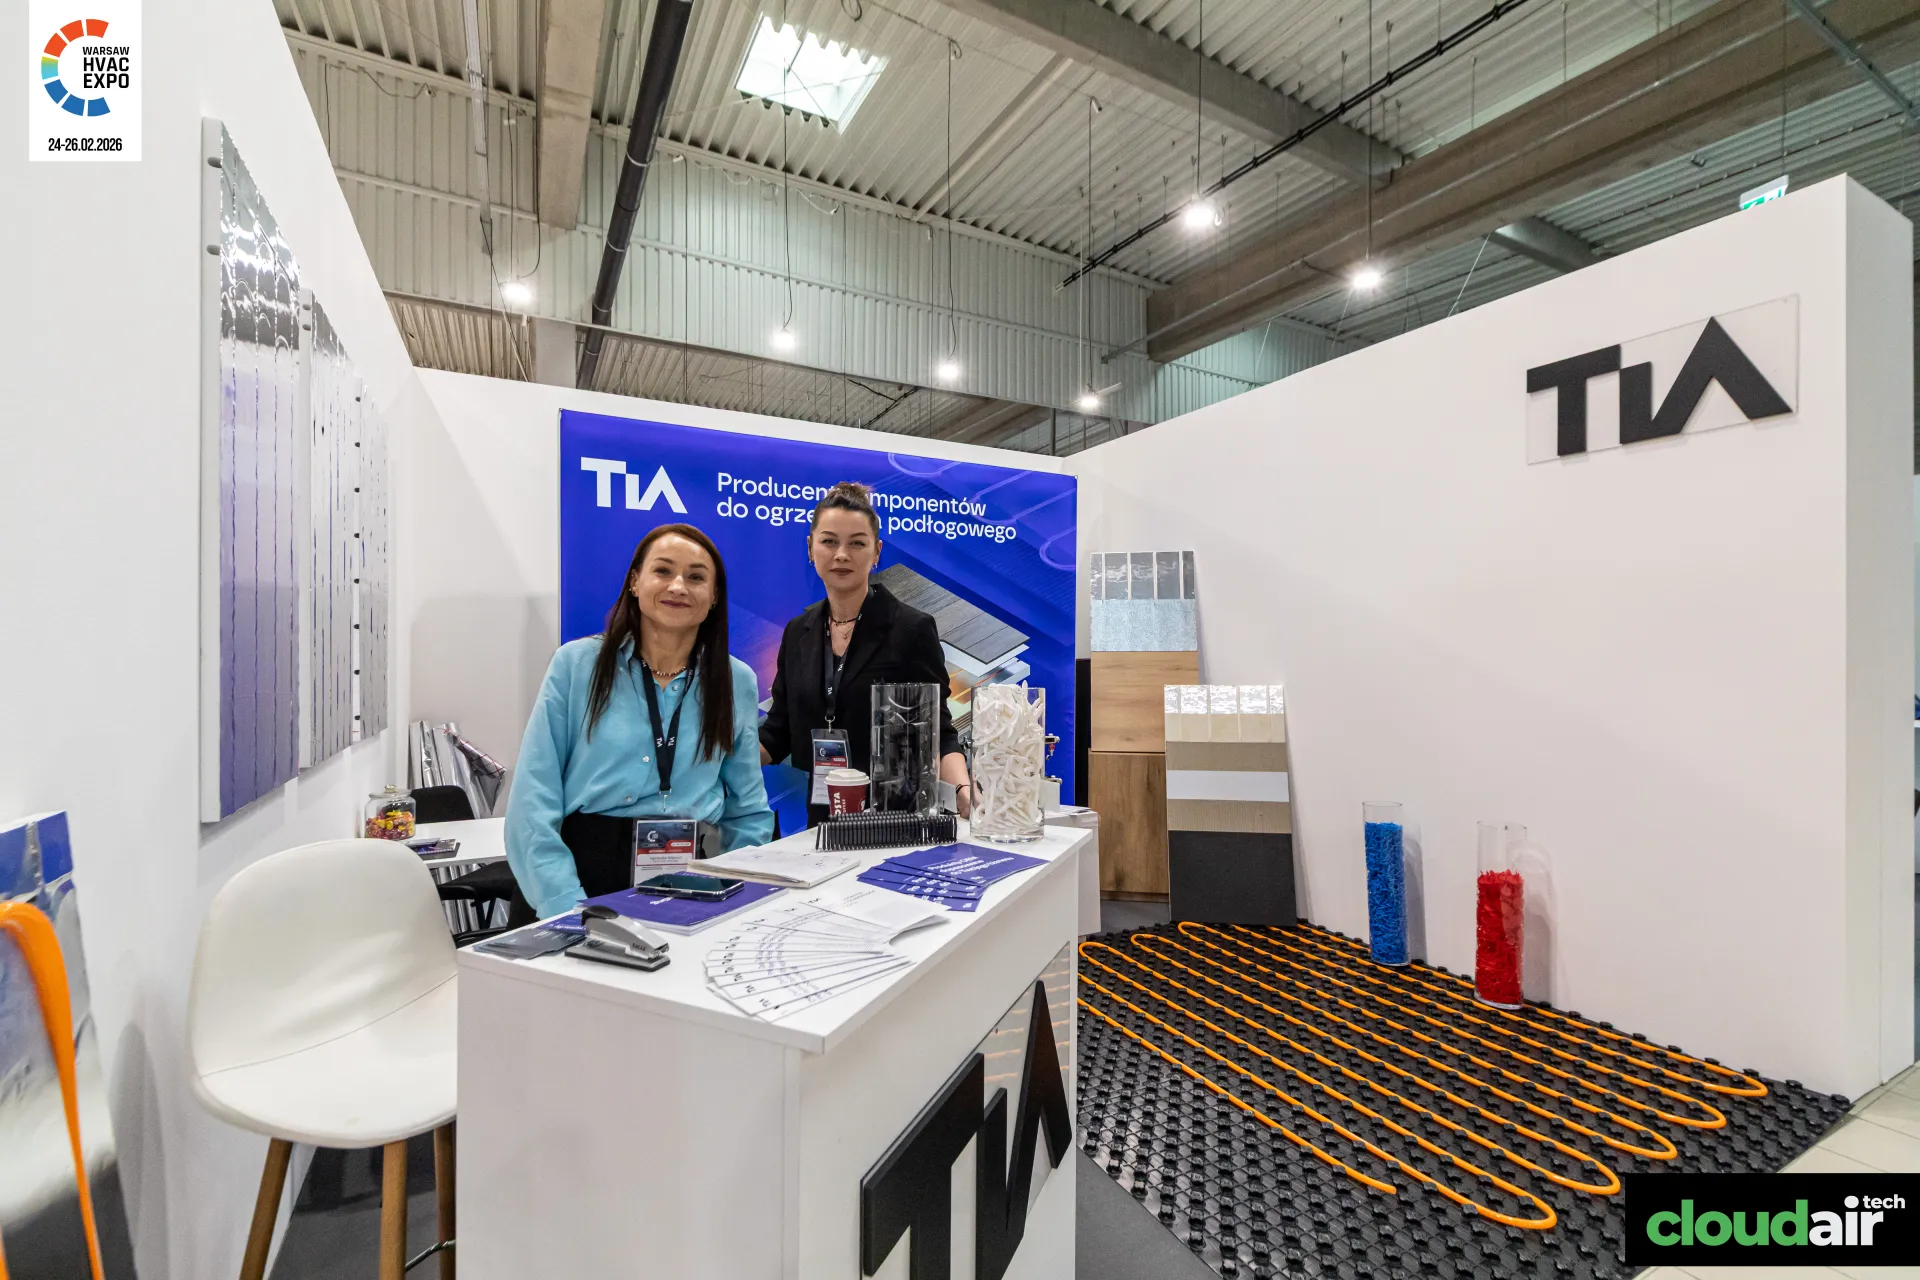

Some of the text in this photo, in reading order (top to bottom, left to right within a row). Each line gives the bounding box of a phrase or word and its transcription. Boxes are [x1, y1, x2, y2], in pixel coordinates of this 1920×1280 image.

[1526, 315, 1793, 457] TIA
[580, 456, 688, 514] TIA
[865, 492, 987, 517] mponentów
[716, 496, 749, 519] do
[888, 514, 1017, 544] podłogowego
[833, 792, 843, 815] OSTA
[863, 978, 1073, 1280] TIA
